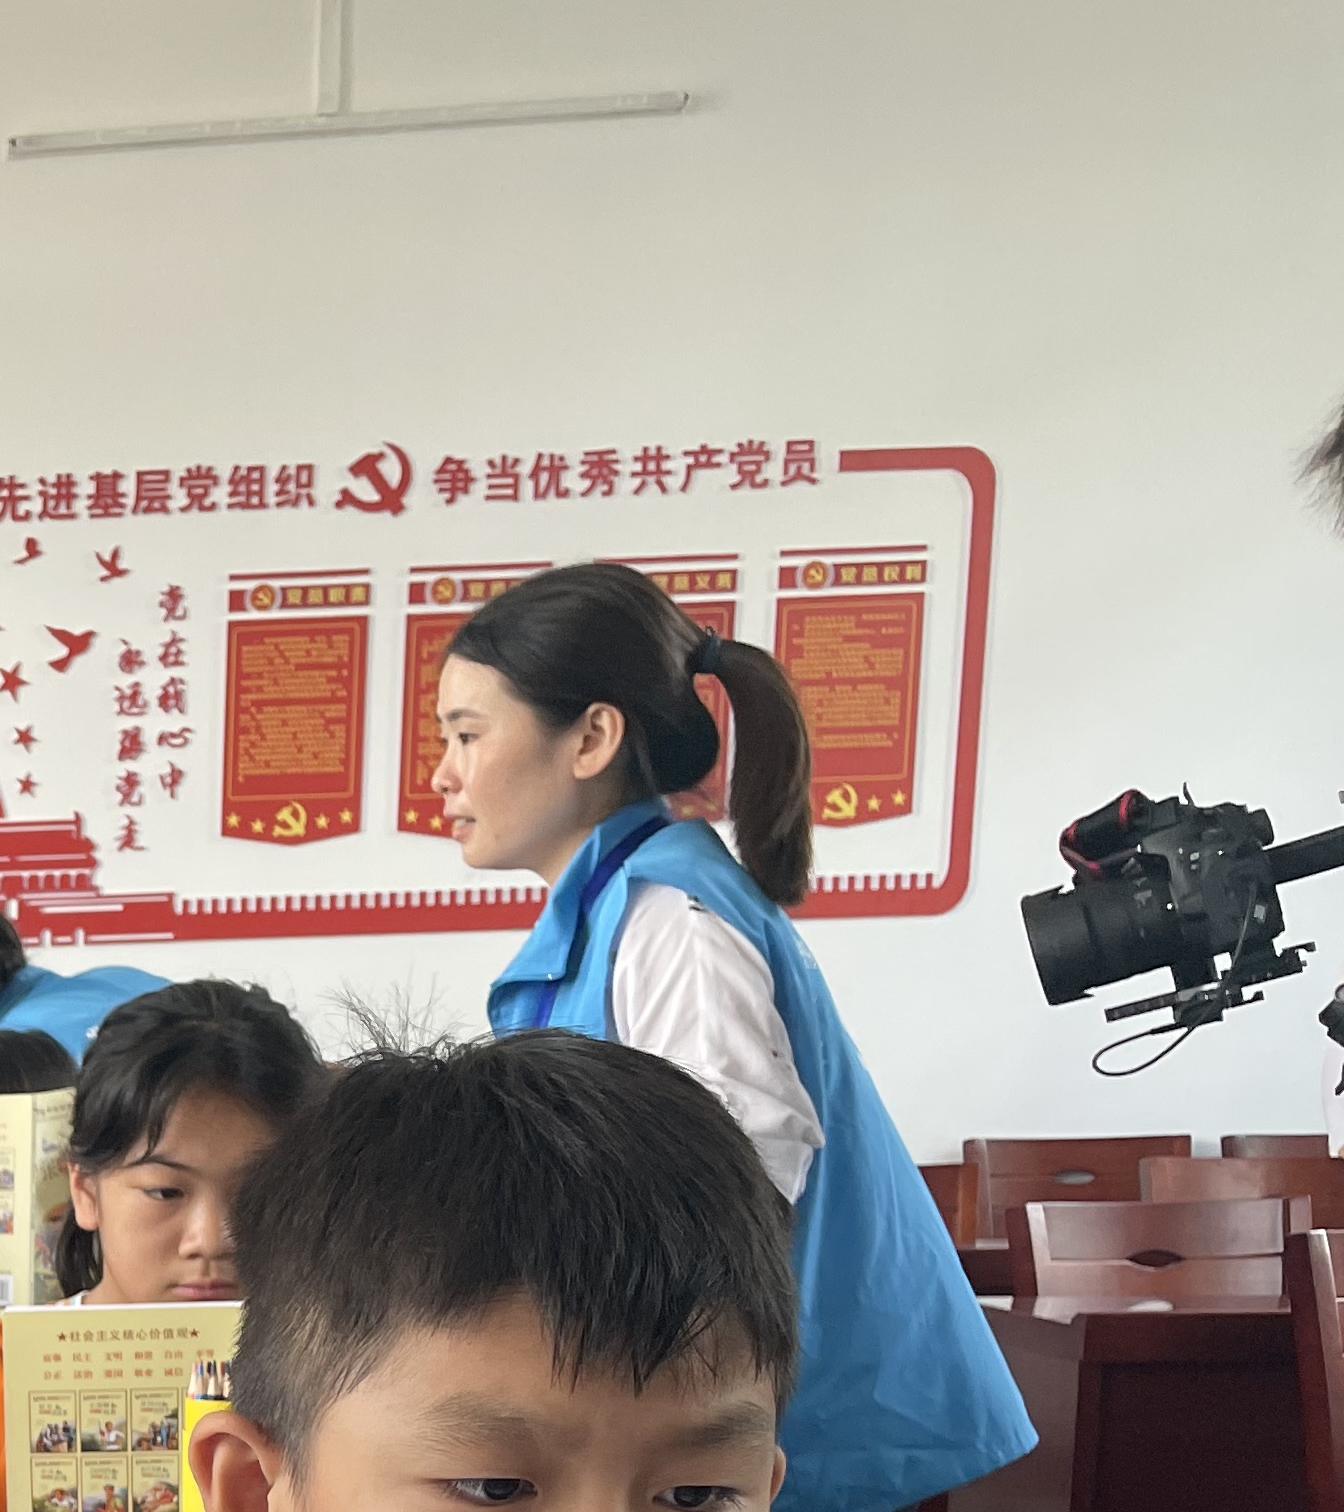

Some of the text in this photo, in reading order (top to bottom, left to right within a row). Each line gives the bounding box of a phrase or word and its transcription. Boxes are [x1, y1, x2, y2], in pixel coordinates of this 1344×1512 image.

[432, 439, 821, 506] 争当优秀共产党员
[113, 637, 149, 852] 永远跟党走
[155, 583, 195, 799] 党在我心中
[69, 1327, 189, 1343] 社会主义核心价值观
